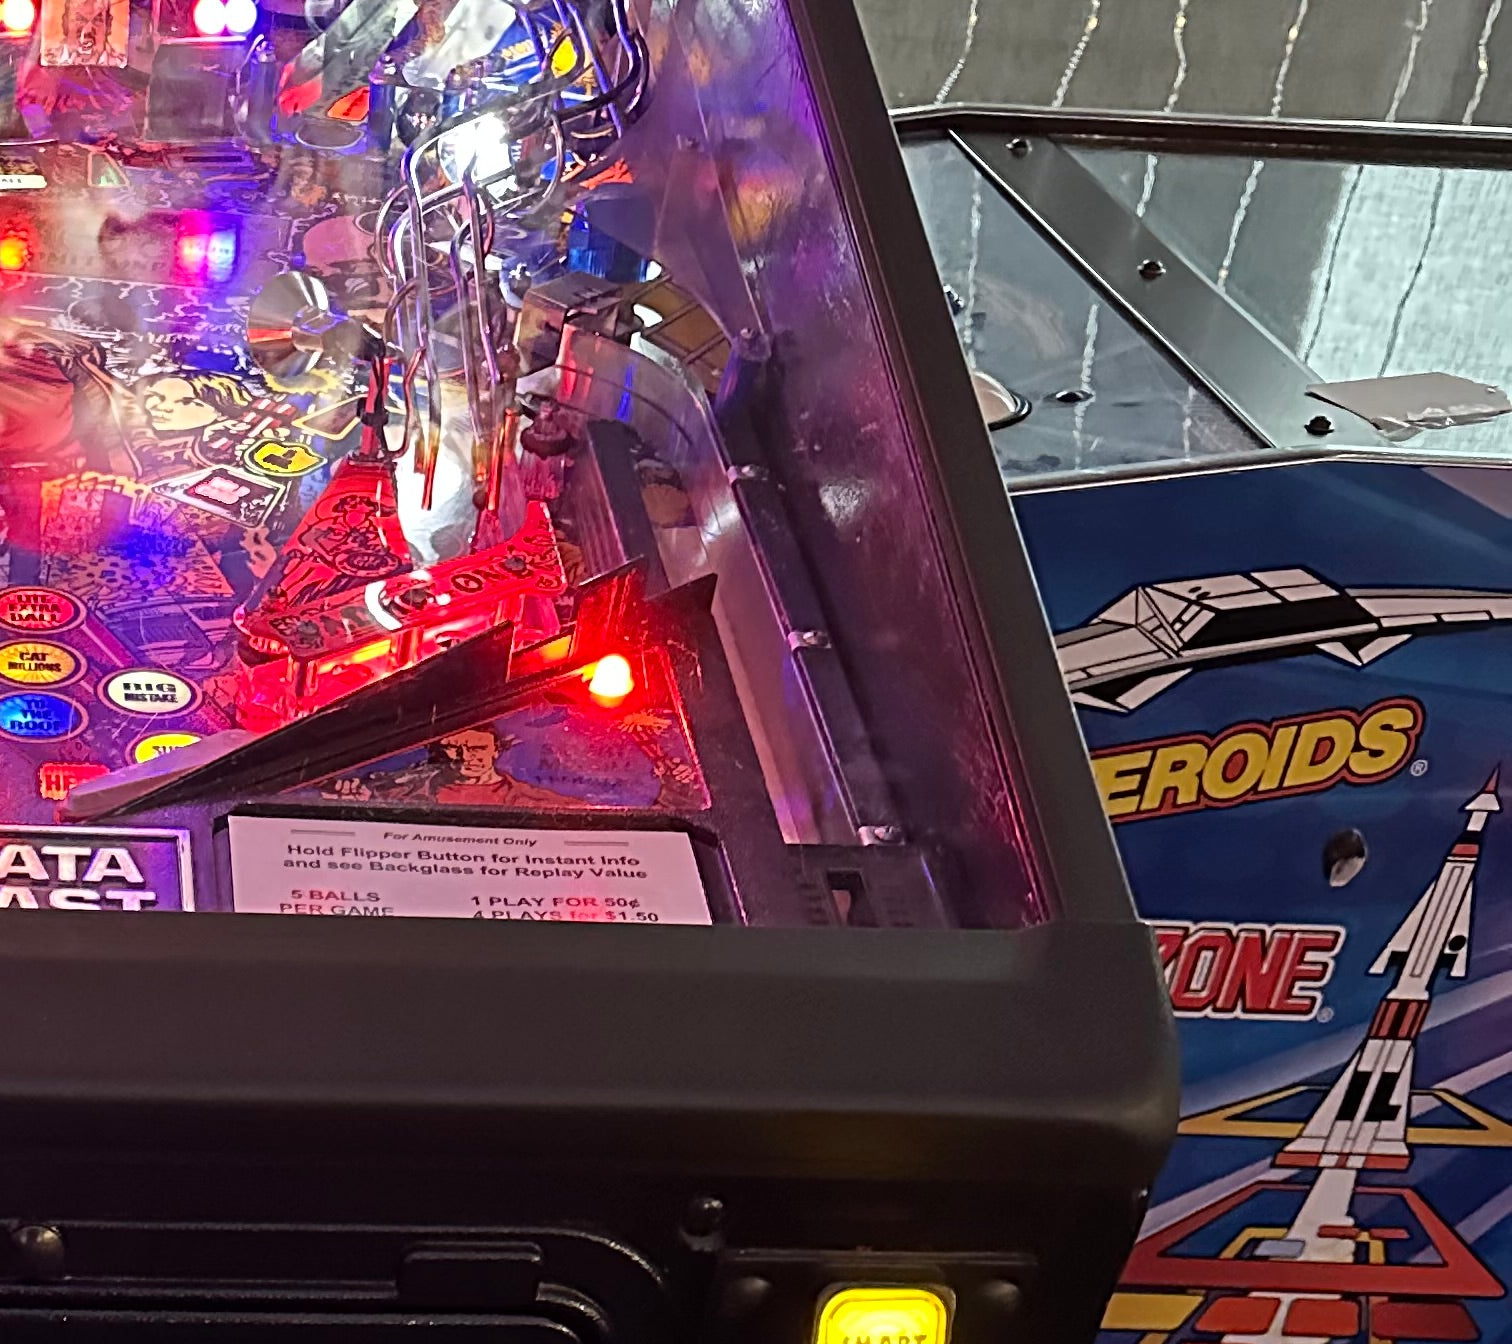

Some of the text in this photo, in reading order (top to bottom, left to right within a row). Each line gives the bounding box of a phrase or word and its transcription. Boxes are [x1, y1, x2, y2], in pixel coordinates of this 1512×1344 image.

[123, 682, 177, 692] BIG
[20, 709, 53, 720] THE
[383, 831, 538, 848] For Amusement Only
[287, 844, 641, 867] Hold Flipper Button for Instant Info
[283, 858, 648, 879] and see Backglass for Replay Value
[291, 889, 381, 902] 5 BALLS
[471, 895, 641, 909] 1 PLAY FOR 50¢
[279, 903, 395, 917] PER GAME
[472, 910, 659, 923] 4 PLAYS for $1.50
